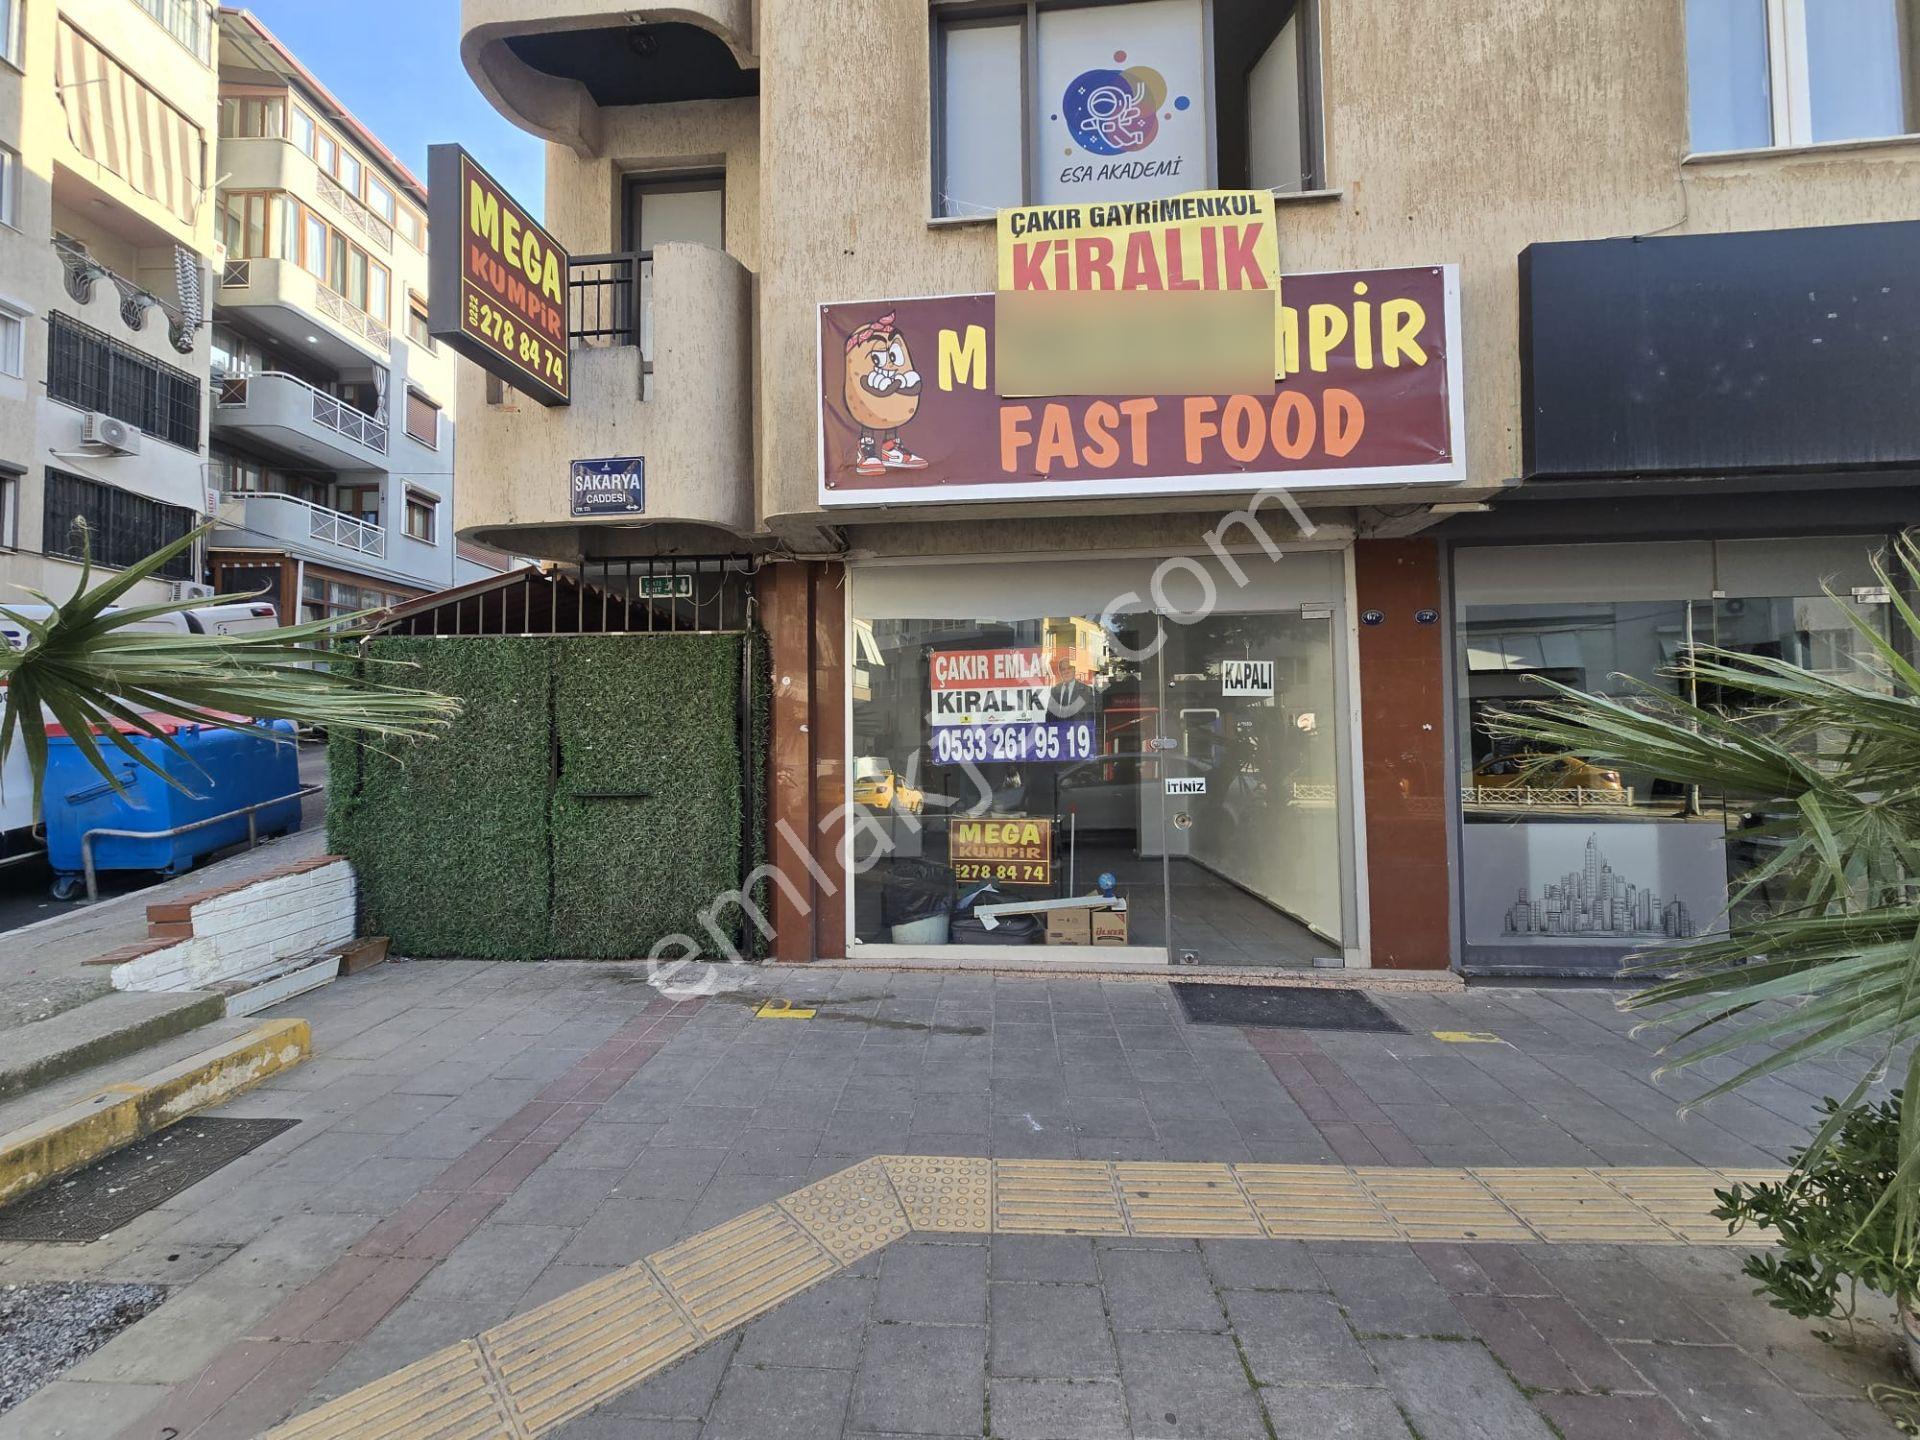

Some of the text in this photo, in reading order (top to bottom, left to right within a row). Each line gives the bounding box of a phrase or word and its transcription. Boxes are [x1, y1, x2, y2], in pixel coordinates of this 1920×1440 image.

[1060, 155, 1183, 183] ESA AKADEMİ
[1010, 209, 1081, 238] ÇAKIR
[470, 179, 562, 305] MEGA
[480, 304, 564, 386] 278 84 74
[1000, 388, 1366, 475] FAST FOOD
[575, 473, 641, 491] SAKARYA
[935, 652, 1056, 688] ÇAKIR EMLAK
[1225, 663, 1272, 690] KAPALI
[938, 724, 1091, 761] 0533 261 95 19
[1167, 780, 1205, 794] İTİNİZ
[959, 823, 1041, 845] MEGA
[960, 864, 991, 879] 278
[996, 865, 1018, 880] 84
[1024, 866, 1045, 881] 74
